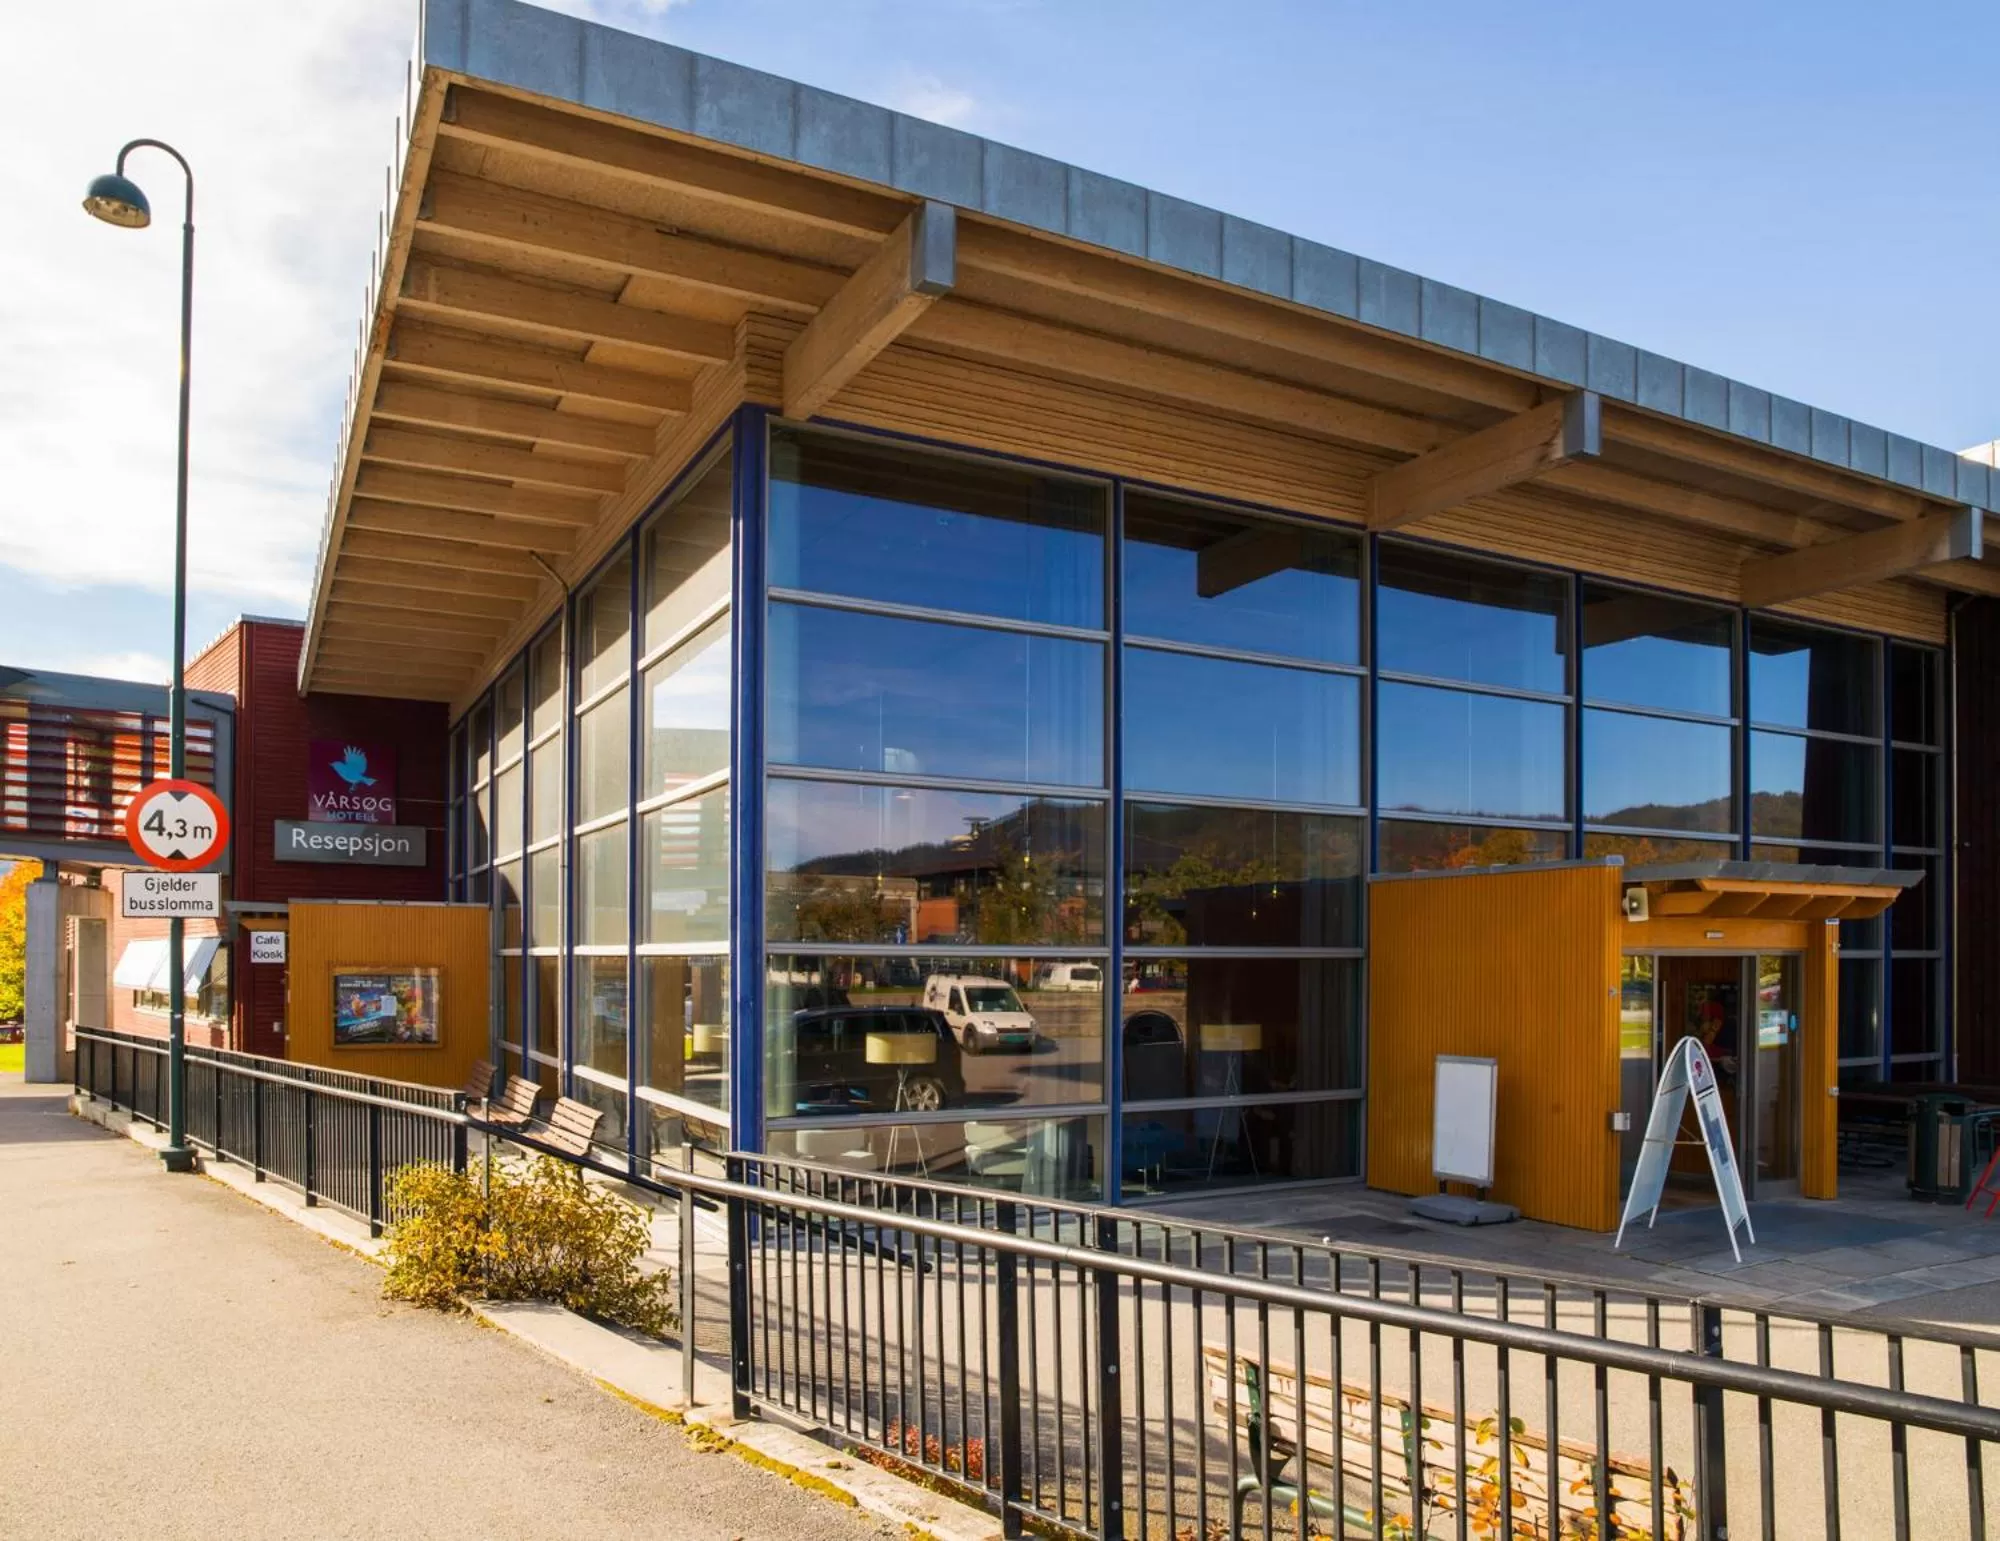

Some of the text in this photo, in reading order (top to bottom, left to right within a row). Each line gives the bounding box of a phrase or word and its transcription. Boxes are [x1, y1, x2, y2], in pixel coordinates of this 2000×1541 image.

[313, 791, 392, 811] VÅRSØG
[327, 810, 378, 822] HOTELL
[143, 809, 212, 840] 4,3 m
[291, 827, 409, 857] Resepsjon
[144, 877, 197, 894] Gjelder
[129, 897, 214, 911] busslomma
[255, 935, 281, 945] Café
[252, 949, 283, 959] Kiosk
